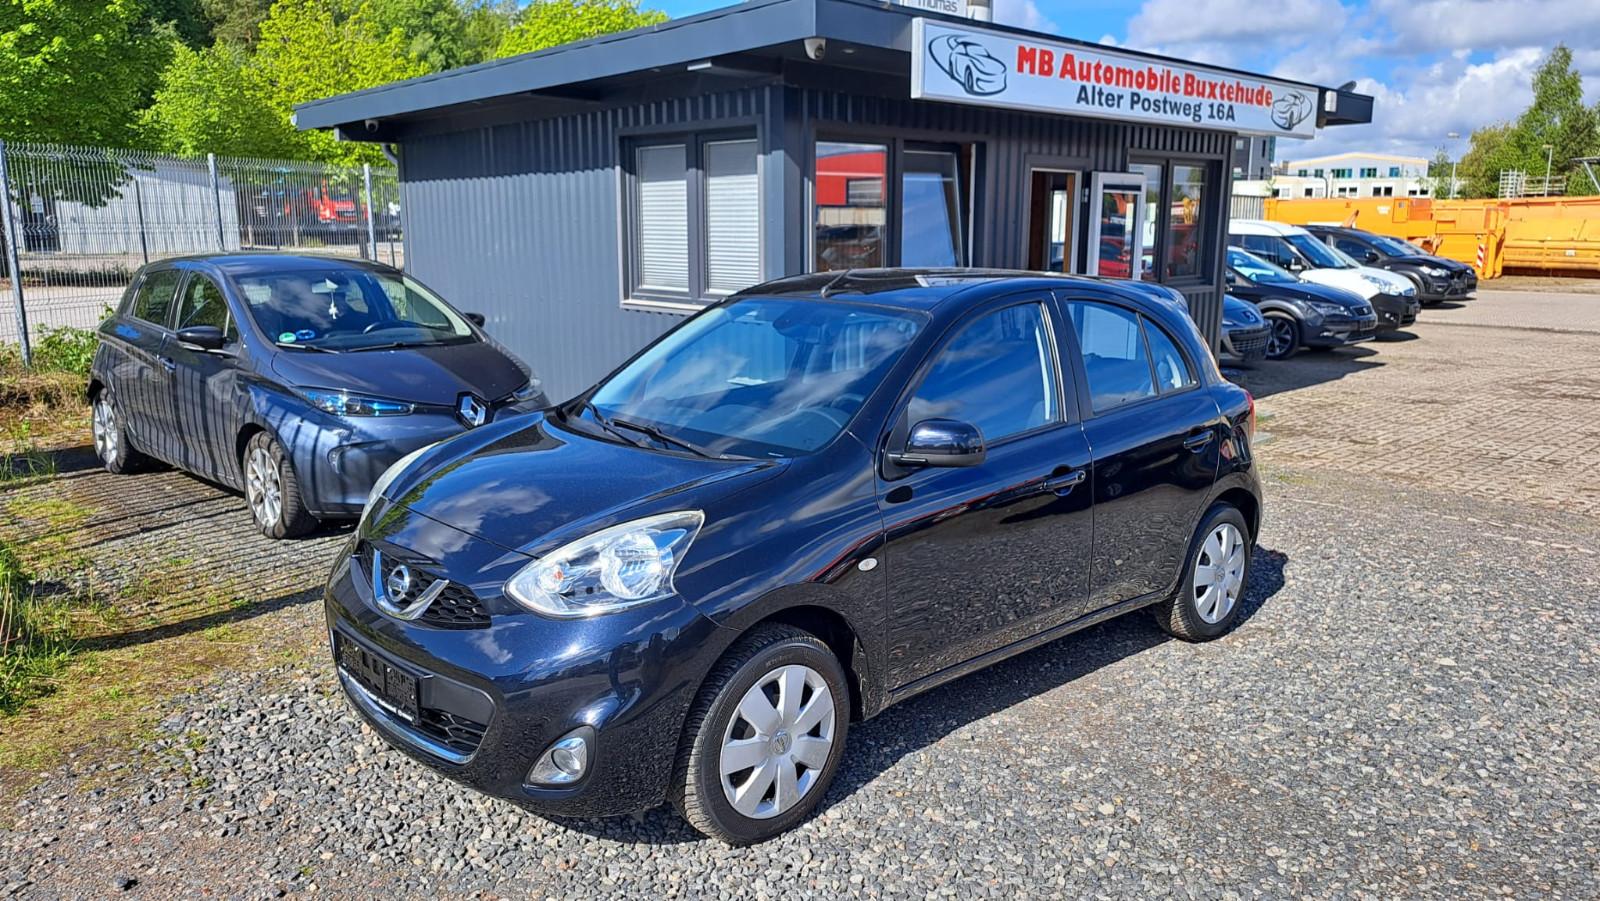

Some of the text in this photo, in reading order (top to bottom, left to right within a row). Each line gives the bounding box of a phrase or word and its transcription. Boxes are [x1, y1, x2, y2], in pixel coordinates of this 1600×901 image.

[1017, 45, 1273, 107] MB Automobile Buxtehude
[1076, 84, 1236, 122] Alter Postweg 16A
